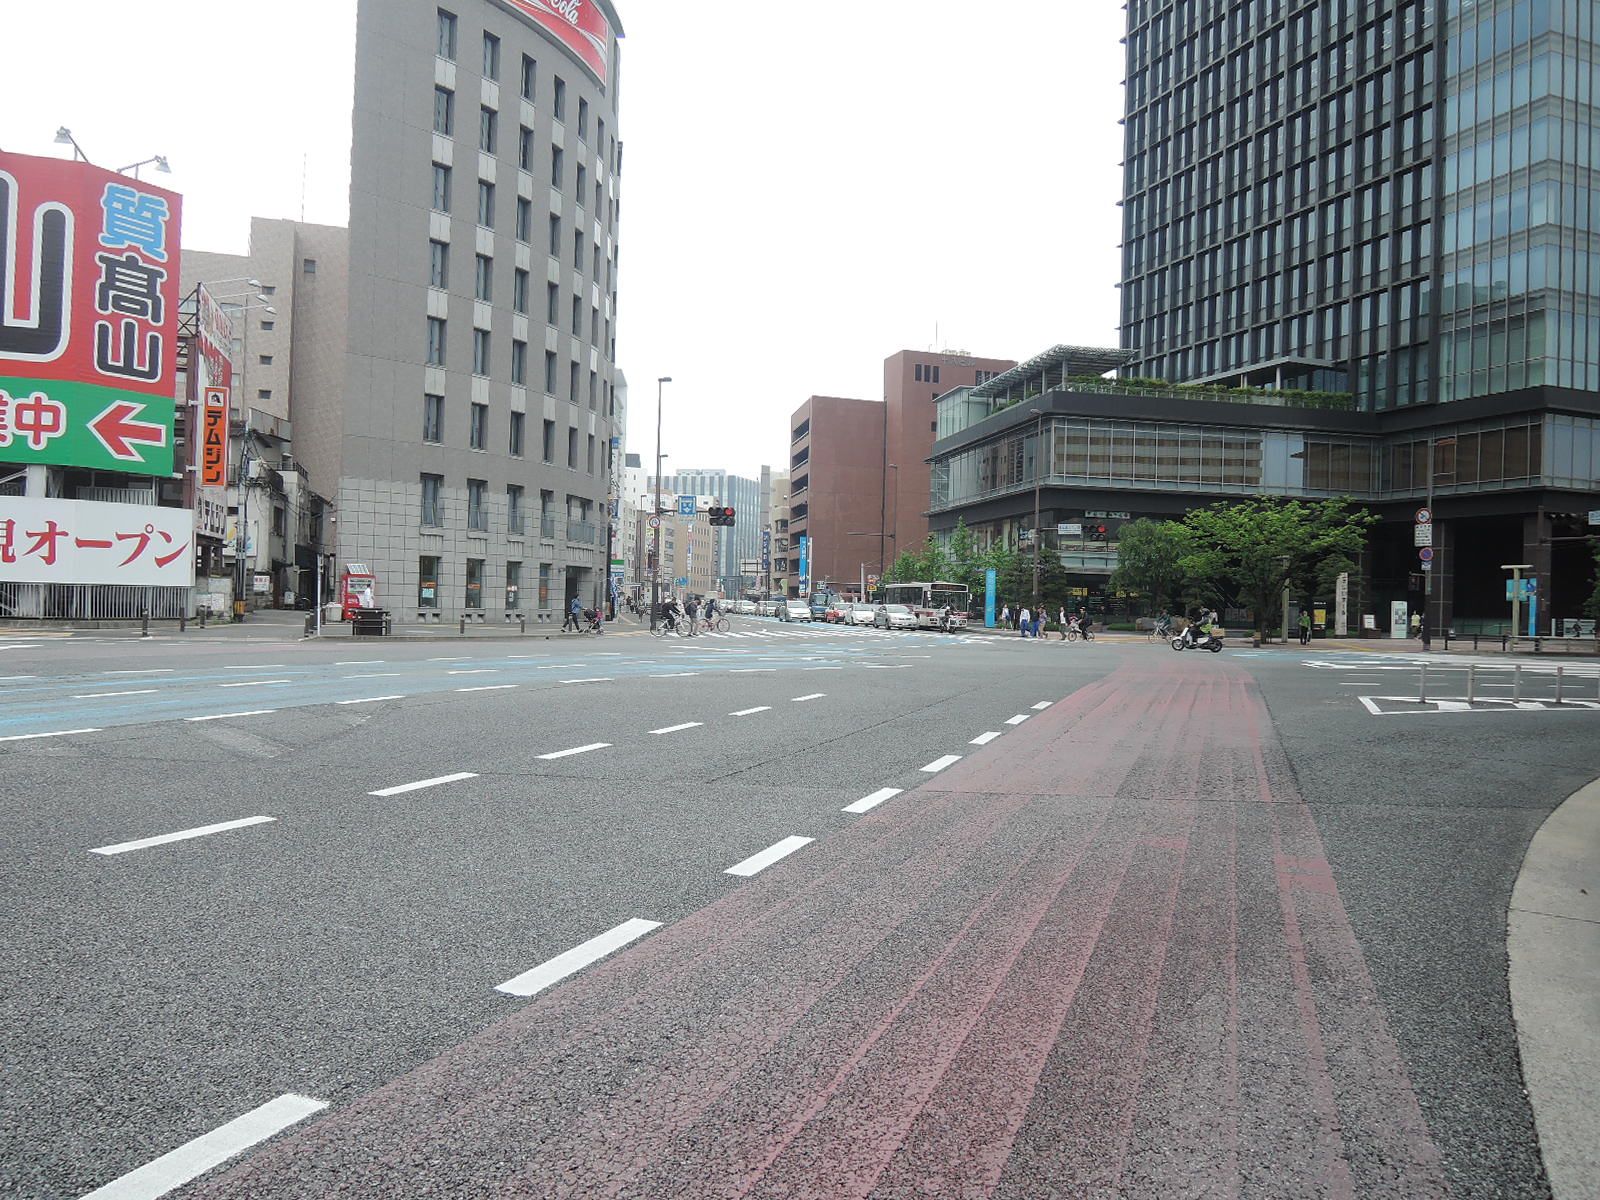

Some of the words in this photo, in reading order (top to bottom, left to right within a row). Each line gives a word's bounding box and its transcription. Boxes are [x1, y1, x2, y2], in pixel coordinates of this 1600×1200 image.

[0, 391, 64, 449] 中
[205, 409, 223, 483] テムジン
